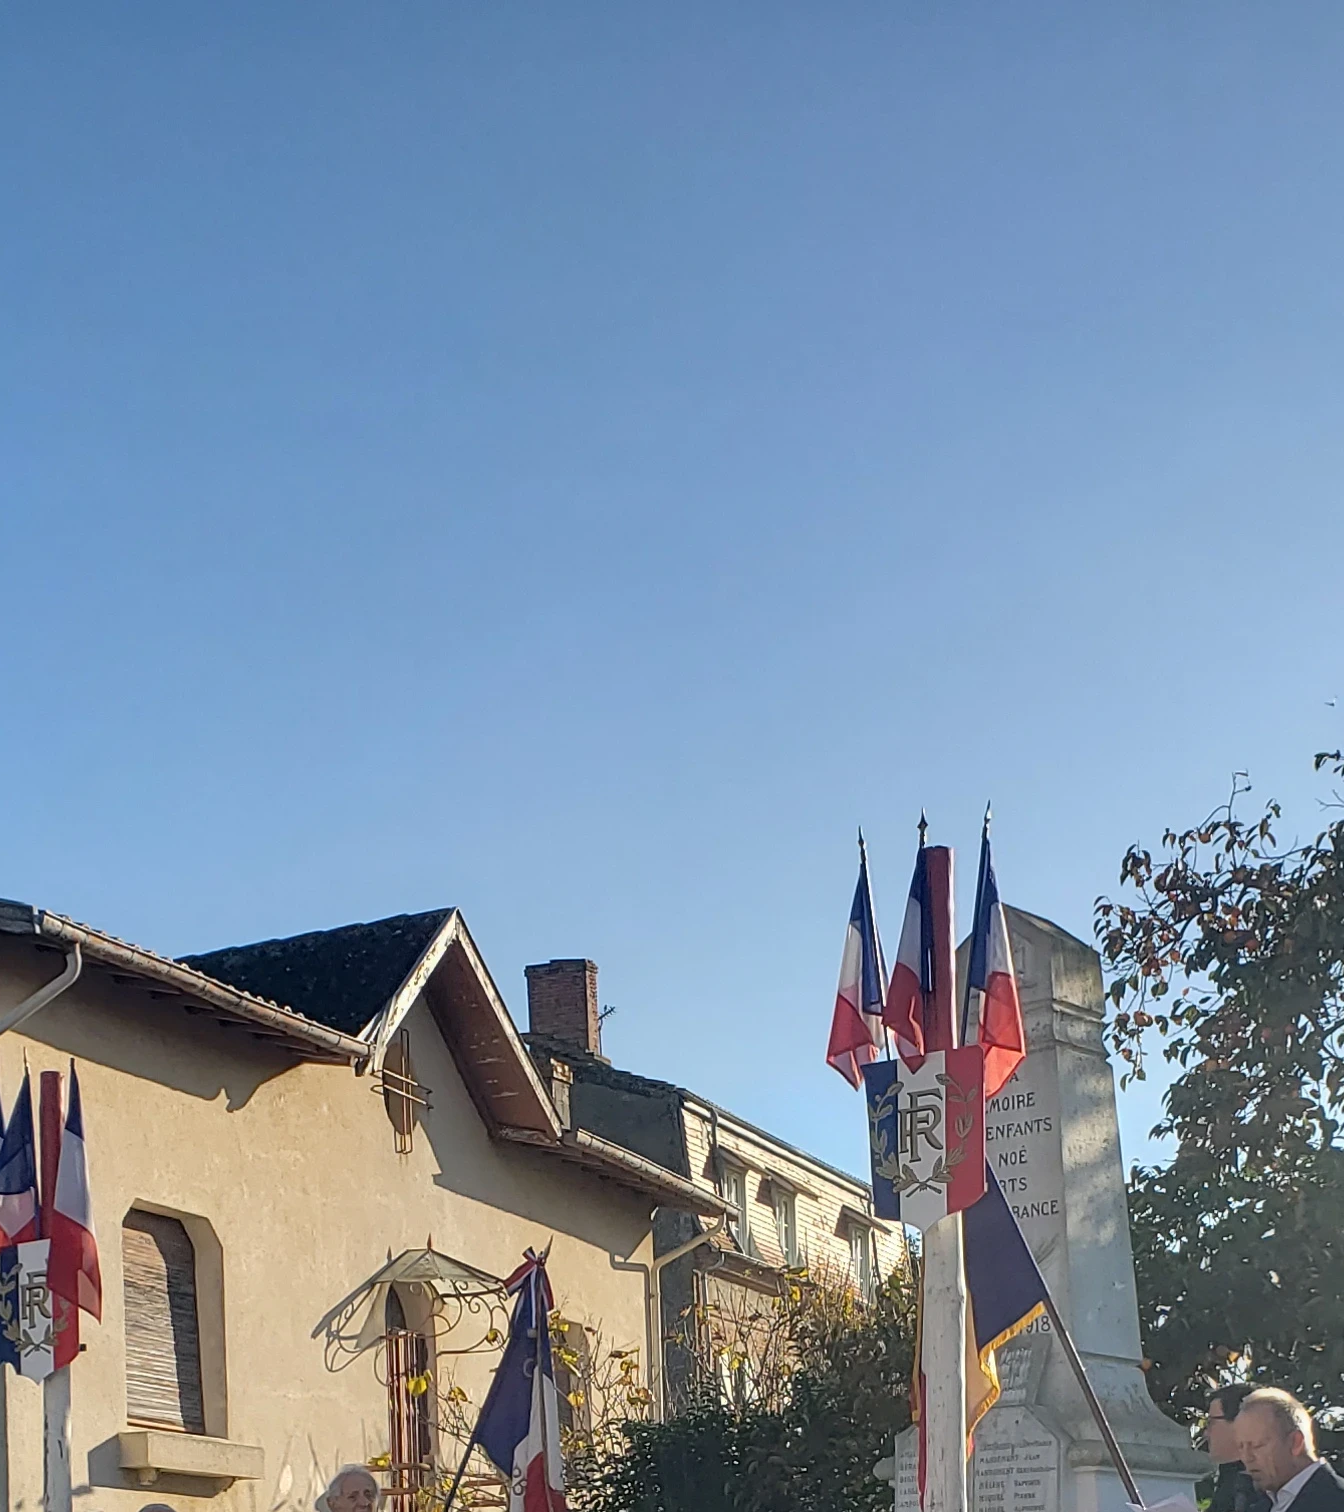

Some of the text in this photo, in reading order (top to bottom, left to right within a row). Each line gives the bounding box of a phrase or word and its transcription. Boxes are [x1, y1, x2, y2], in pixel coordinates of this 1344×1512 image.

[986, 1092, 1036, 1114] MOIRE
[985, 1117, 1052, 1140] ENFANTS
[998, 1145, 1028, 1168] NOÉ
[998, 1177, 1028, 1193] RTS
[1011, 1200, 1060, 1220] RANCE
[1019, 1315, 1051, 1334] 918
